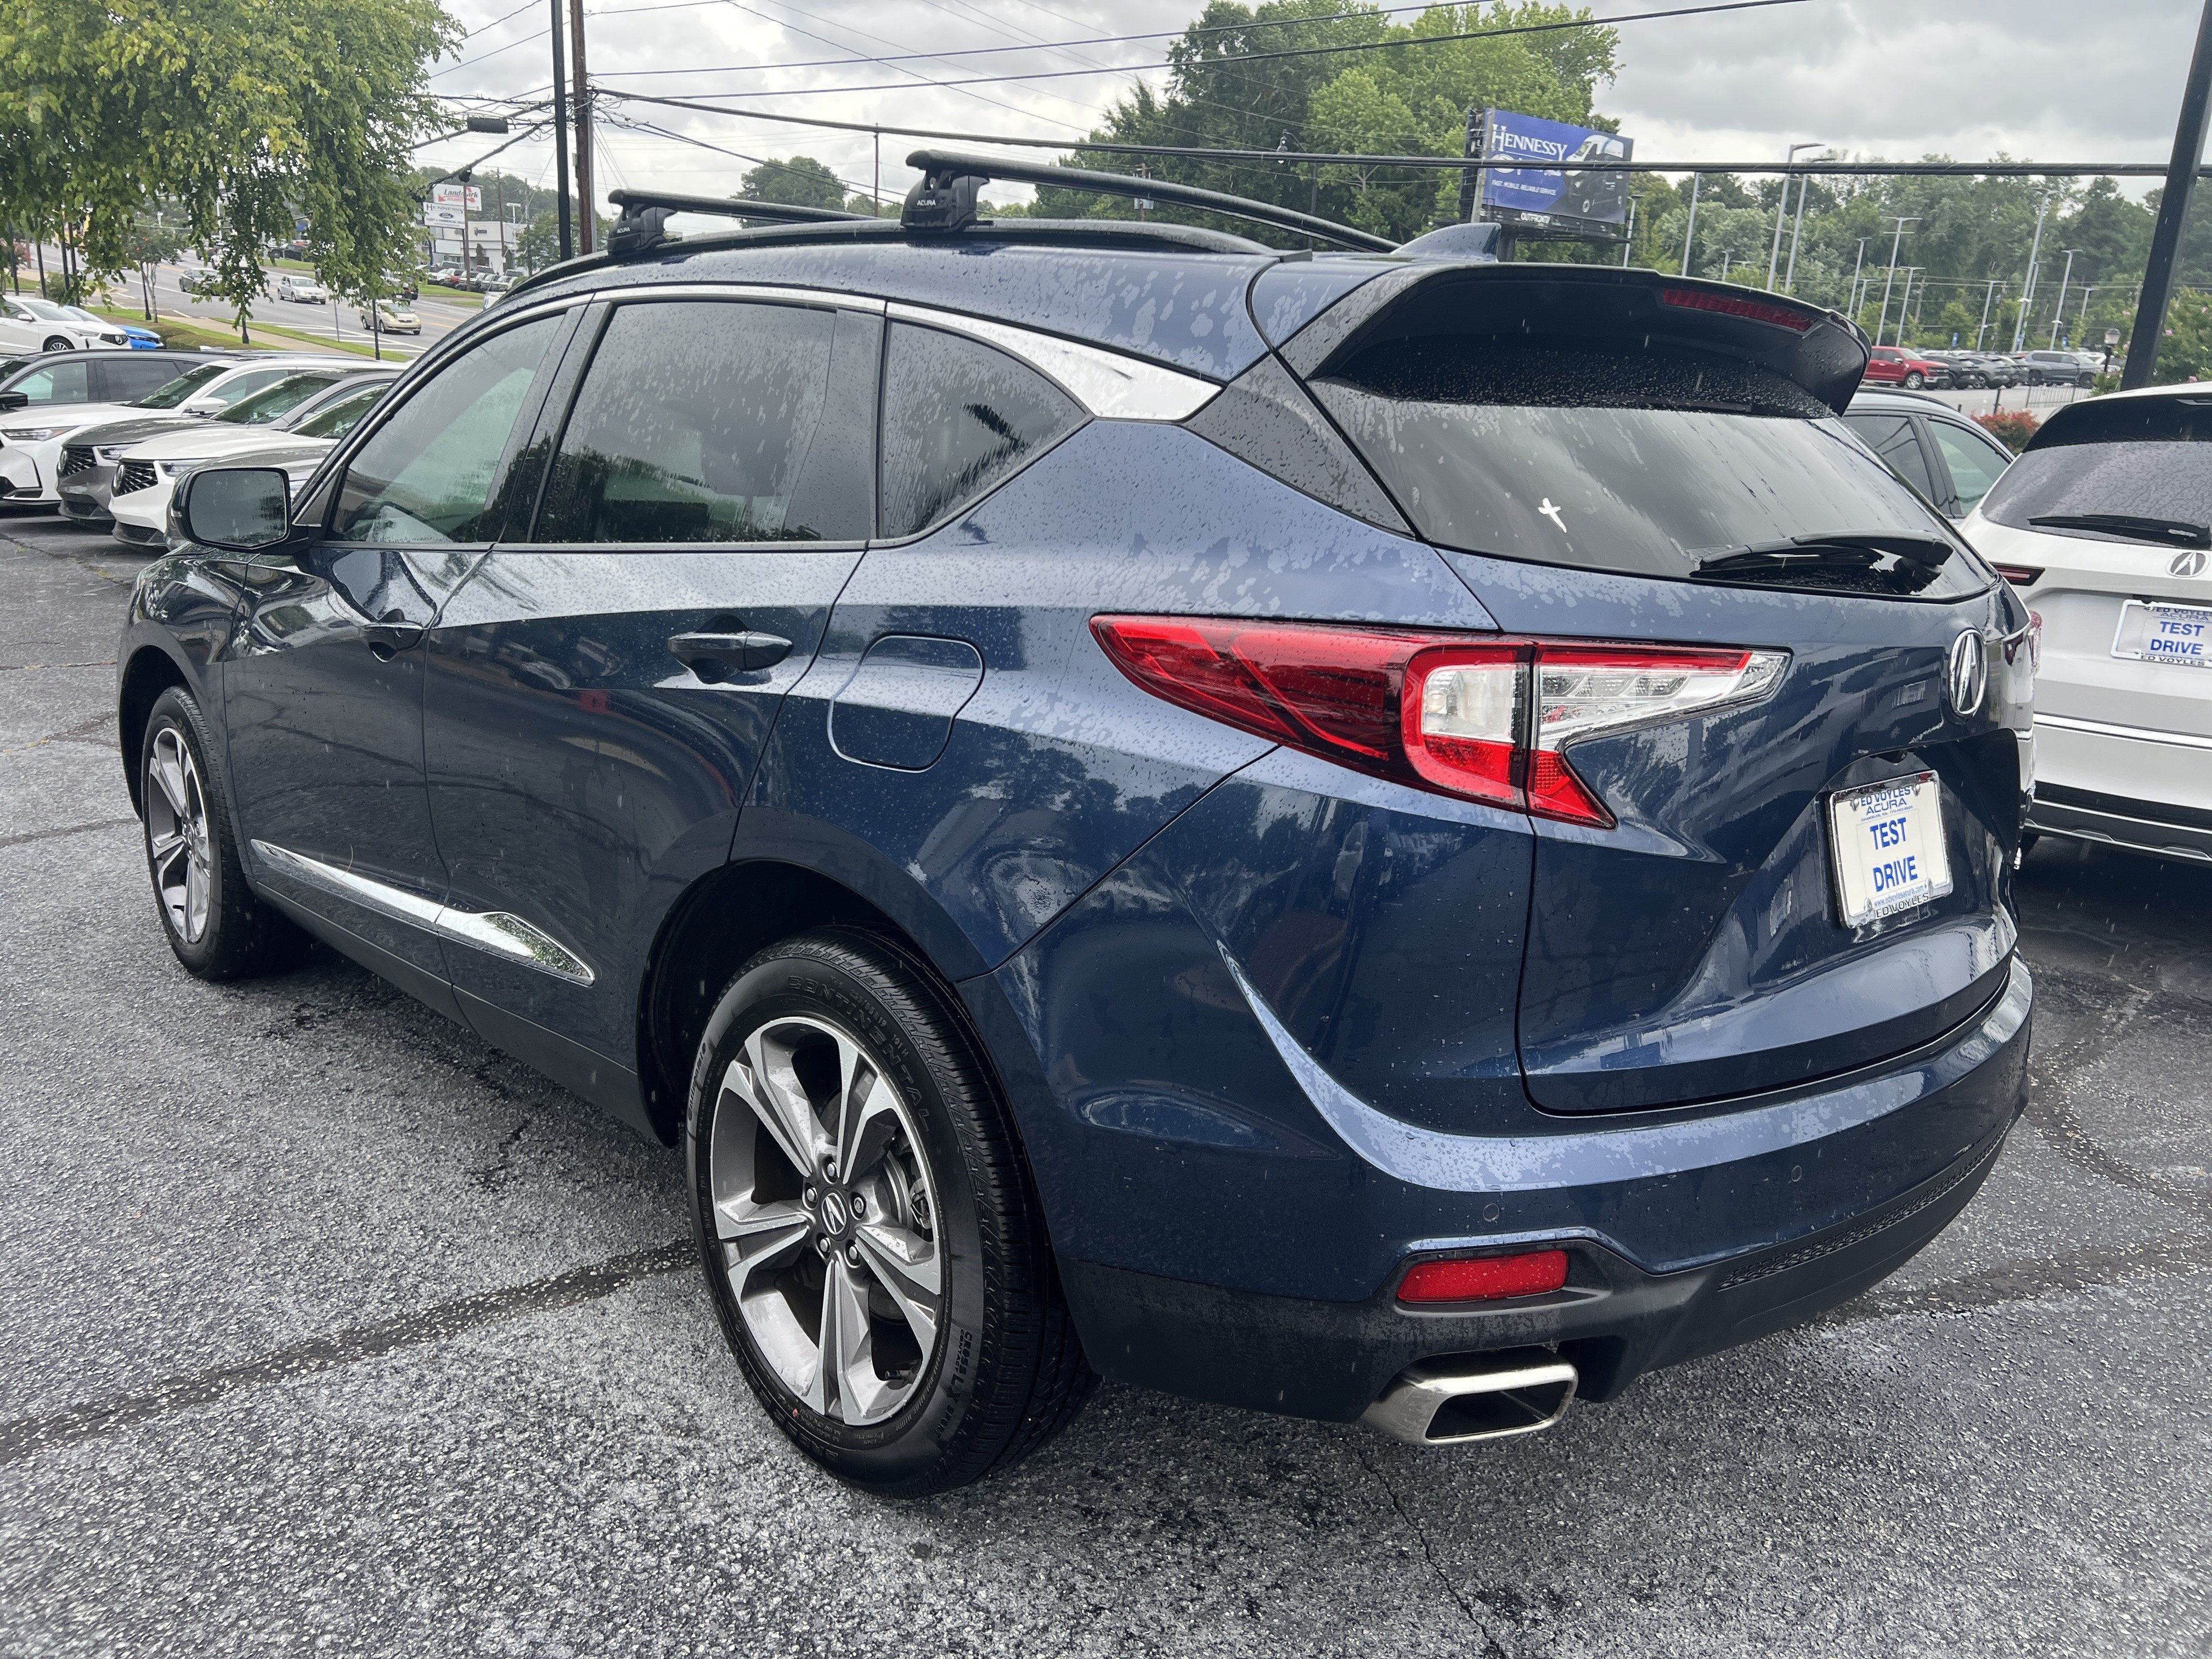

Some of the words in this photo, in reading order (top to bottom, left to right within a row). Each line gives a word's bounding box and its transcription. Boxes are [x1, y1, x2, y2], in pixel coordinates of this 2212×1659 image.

[1491, 124, 1568, 162] HENNESSY
[2160, 612, 2209, 620] ACURA
[2160, 621, 2204, 636] TEST
[2150, 639, 2204, 655] DRIVE
[1861, 795, 1872, 806] ED
[1875, 787, 1910, 803] VOYLES
[1866, 797, 1907, 815] ACURA
[1870, 817, 1907, 850] TEST
[1872, 855, 1918, 893] DRIVE
[1876, 906, 1889, 918] ED
[1891, 893, 1929, 912] VOYLES
[955, 1328, 964, 1373] CONTACT
[958, 1329, 973, 1375] CROSS
[935, 1404, 955, 1437] SPORT
